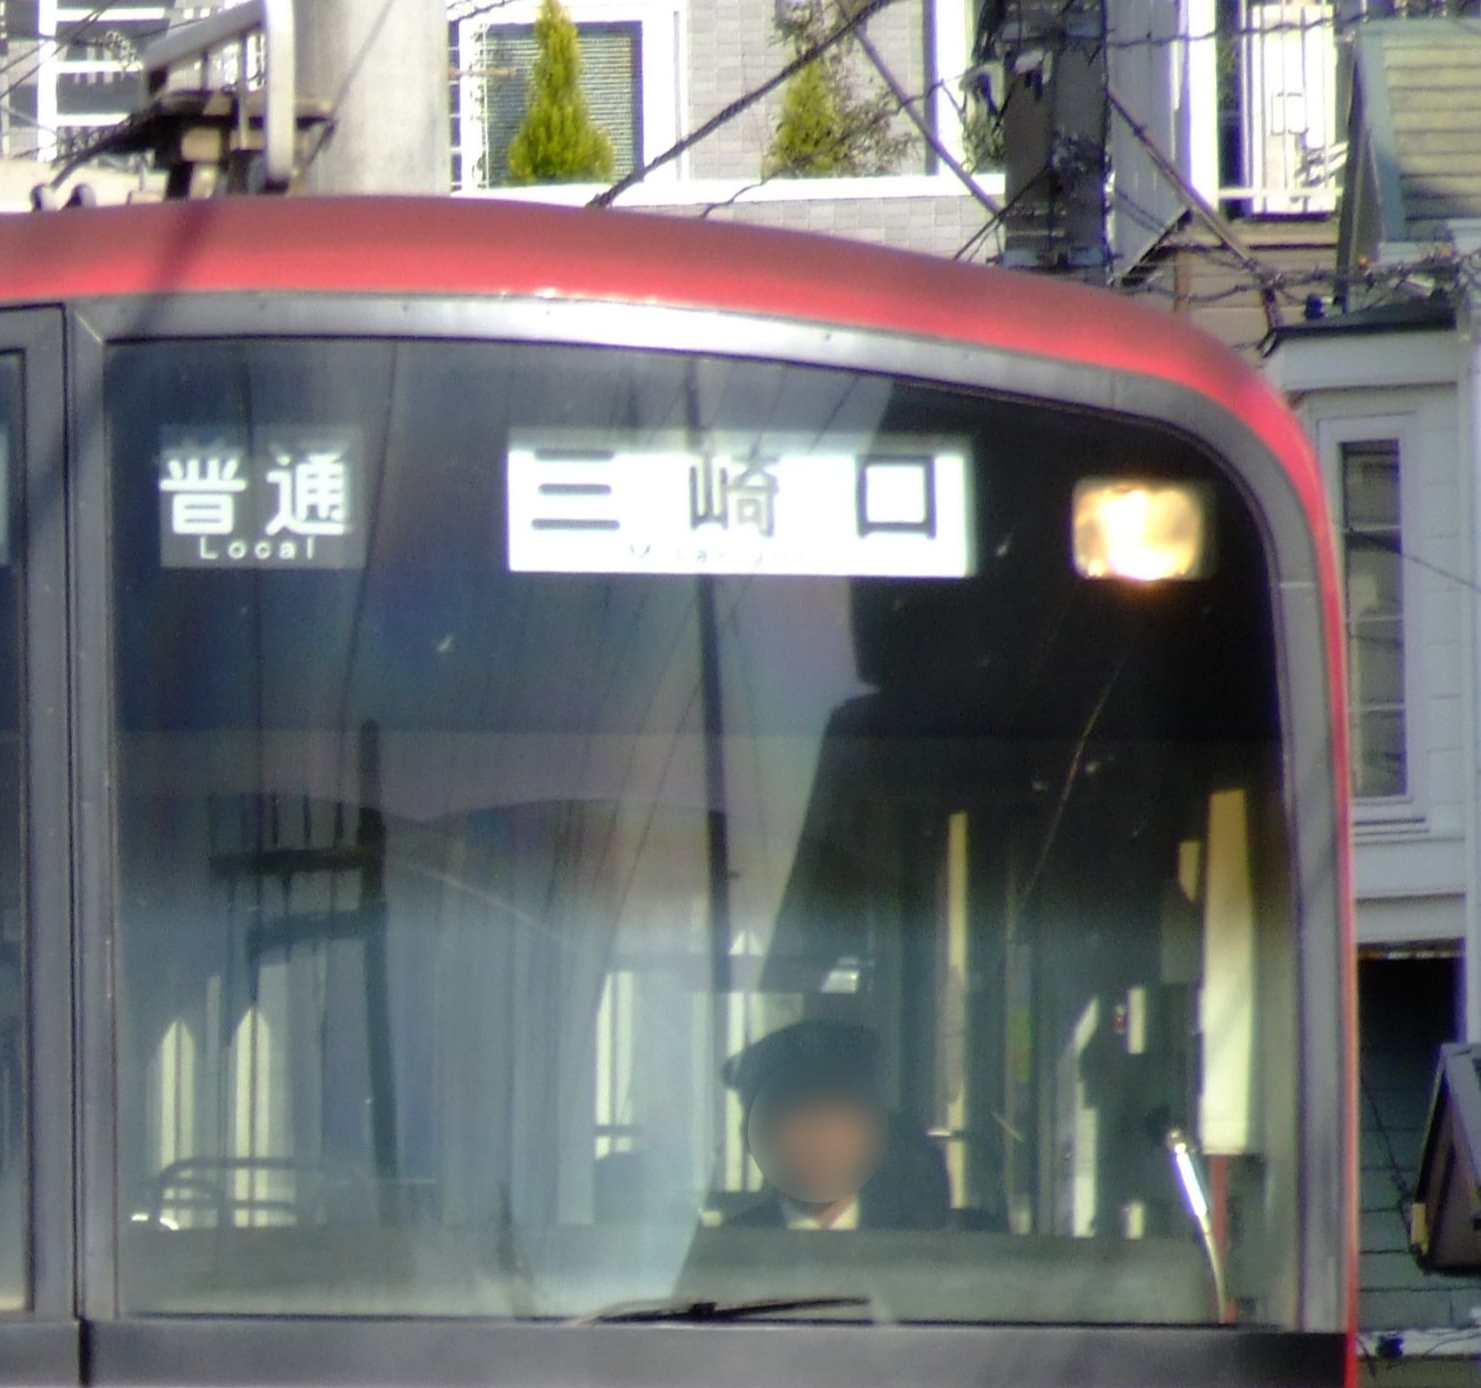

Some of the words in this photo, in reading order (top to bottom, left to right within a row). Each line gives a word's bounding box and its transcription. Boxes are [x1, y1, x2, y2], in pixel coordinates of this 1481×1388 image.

[159, 447, 349, 536] 普通
[531, 440, 937, 538] 三崎口
[200, 535, 315, 560] Local
